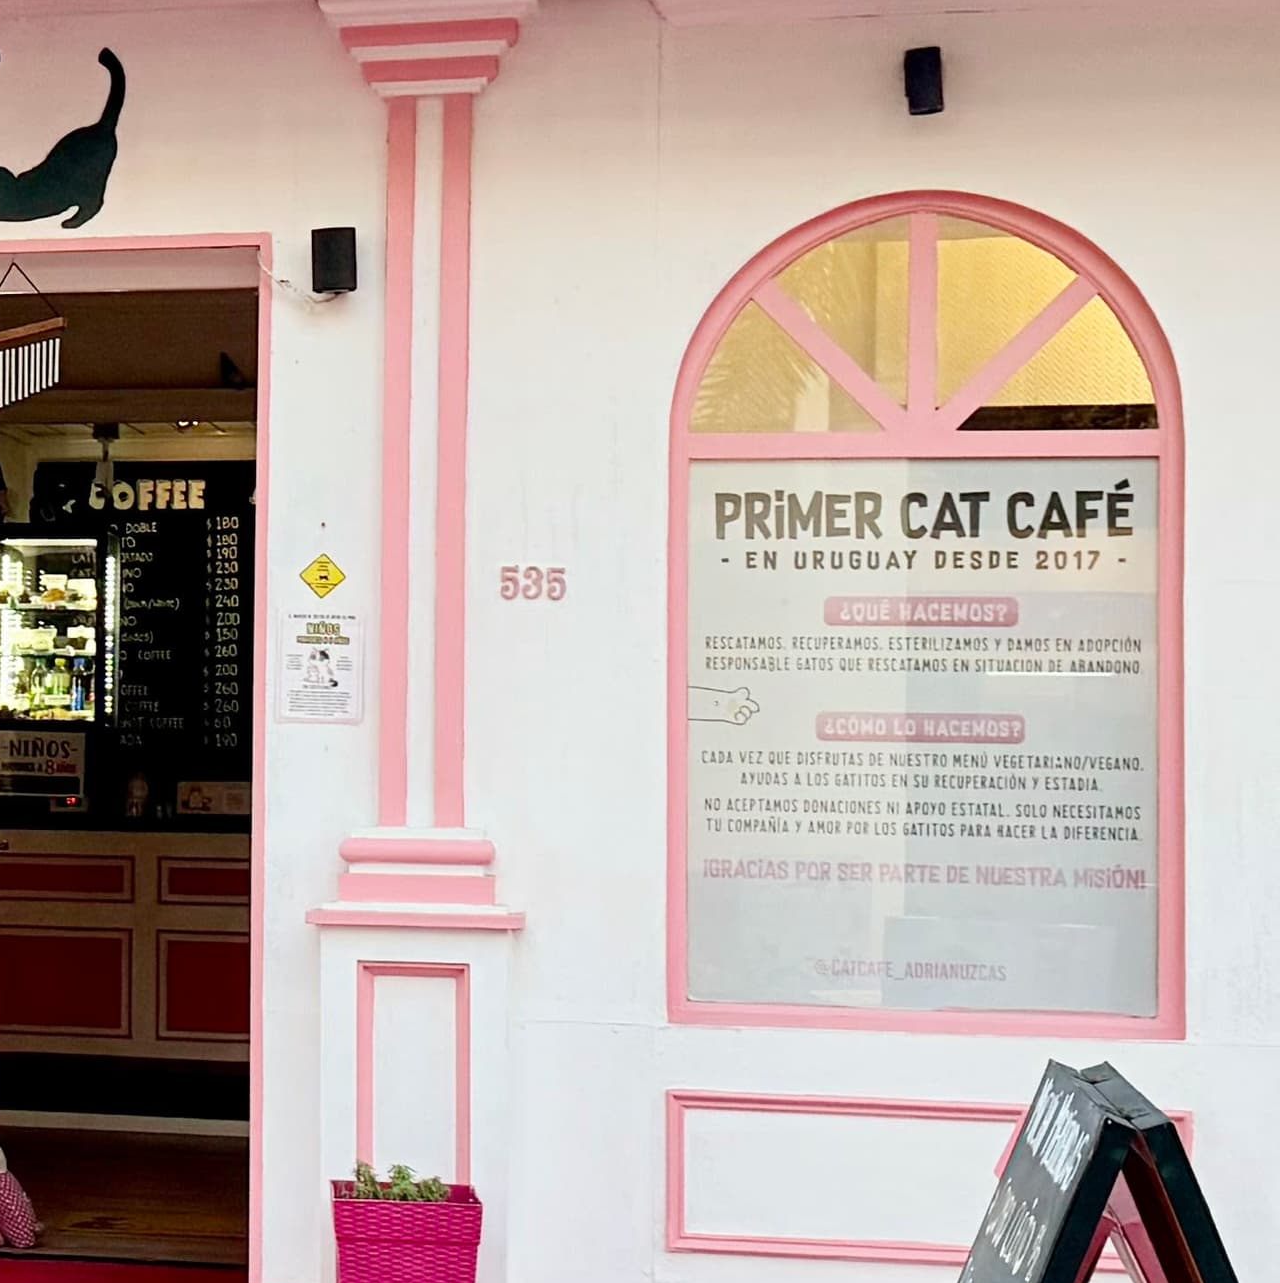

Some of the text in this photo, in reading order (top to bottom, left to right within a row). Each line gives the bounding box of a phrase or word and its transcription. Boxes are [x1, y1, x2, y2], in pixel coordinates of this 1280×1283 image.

[89, 479, 206, 510] COFFEE
[900, 491, 990, 539] CAT
[1007, 479, 1134, 539] CAFÉ
[746, 550, 778, 570] EN
[794, 550, 918, 570] URUGUAY
[934, 550, 1019, 570] DESDE
[1036, 550, 1101, 570] 2017
[500, 565, 567, 601] 535
[840, 599, 1009, 622] ¿QUÉ HACEMOS?
[889, 636, 989, 652] ESTERILIZAMOS
[994, 638, 1002, 652] Y
[1007, 638, 1050, 652] DAMOS
[1056, 638, 1072, 652] EN
[1077, 636, 1142, 653] ADOPCIÓN
[705, 656, 790, 672] RESPONSABLE
[796, 657, 834, 672] GATOS
[841, 657, 863, 673] QUE
[868, 657, 948, 673] RESCATAMOS
[953, 659, 969, 673] EN
[1048, 659, 1064, 674] DE
[893, 719, 917, 736] LO
[923, 720, 1022, 738] HACEMOS?
[701, 750, 734, 765] CADA
[739, 750, 764, 765] VEZ
[768, 751, 791, 766] QUE
[796, 751, 864, 767] DISFRUTAS
[869, 752, 884, 767] DE
[889, 752, 948, 767] NUESTRO
[953, 751, 988, 768] MENÚ
[740, 772, 788, 787] AYUDAS
[794, 772, 802, 787] A
[807, 772, 830, 787] LOS
[834, 773, 887, 788] GATITOS
[891, 774, 908, 788] EN
[913, 774, 929, 789] SU
[934, 774, 1027, 791] RECUPERACIÓN
[1032, 776, 1039, 790] Y
[704, 798, 721, 812] NO
[726, 798, 798, 813] ACEPTAMOS
[803, 799, 882, 815] DONACIONES
[886, 801, 900, 815] NI
[905, 801, 946, 816] APOYO
[1015, 804, 1047, 818] SOLO
[1053, 804, 1141, 820] NECESITAMOS
[706, 818, 722, 832] TU
[727, 816, 789, 833] COMPAÑÍA
[795, 820, 803, 834] Y
[807, 820, 841, 835] AMOR
[846, 821, 869, 835] POR
[874, 822, 897, 836] LOS
[903, 822, 955, 837] GATITOS
[960, 823, 991, 838] PARA
[997, 824, 1036, 839] HACER
[1041, 825, 1058, 839] LA
[795, 861, 831, 882] POR
[837, 862, 872, 882] SER
[879, 863, 940, 884] PARTE
[946, 864, 970, 885] DE
[976, 864, 1067, 887] NUESTRA
